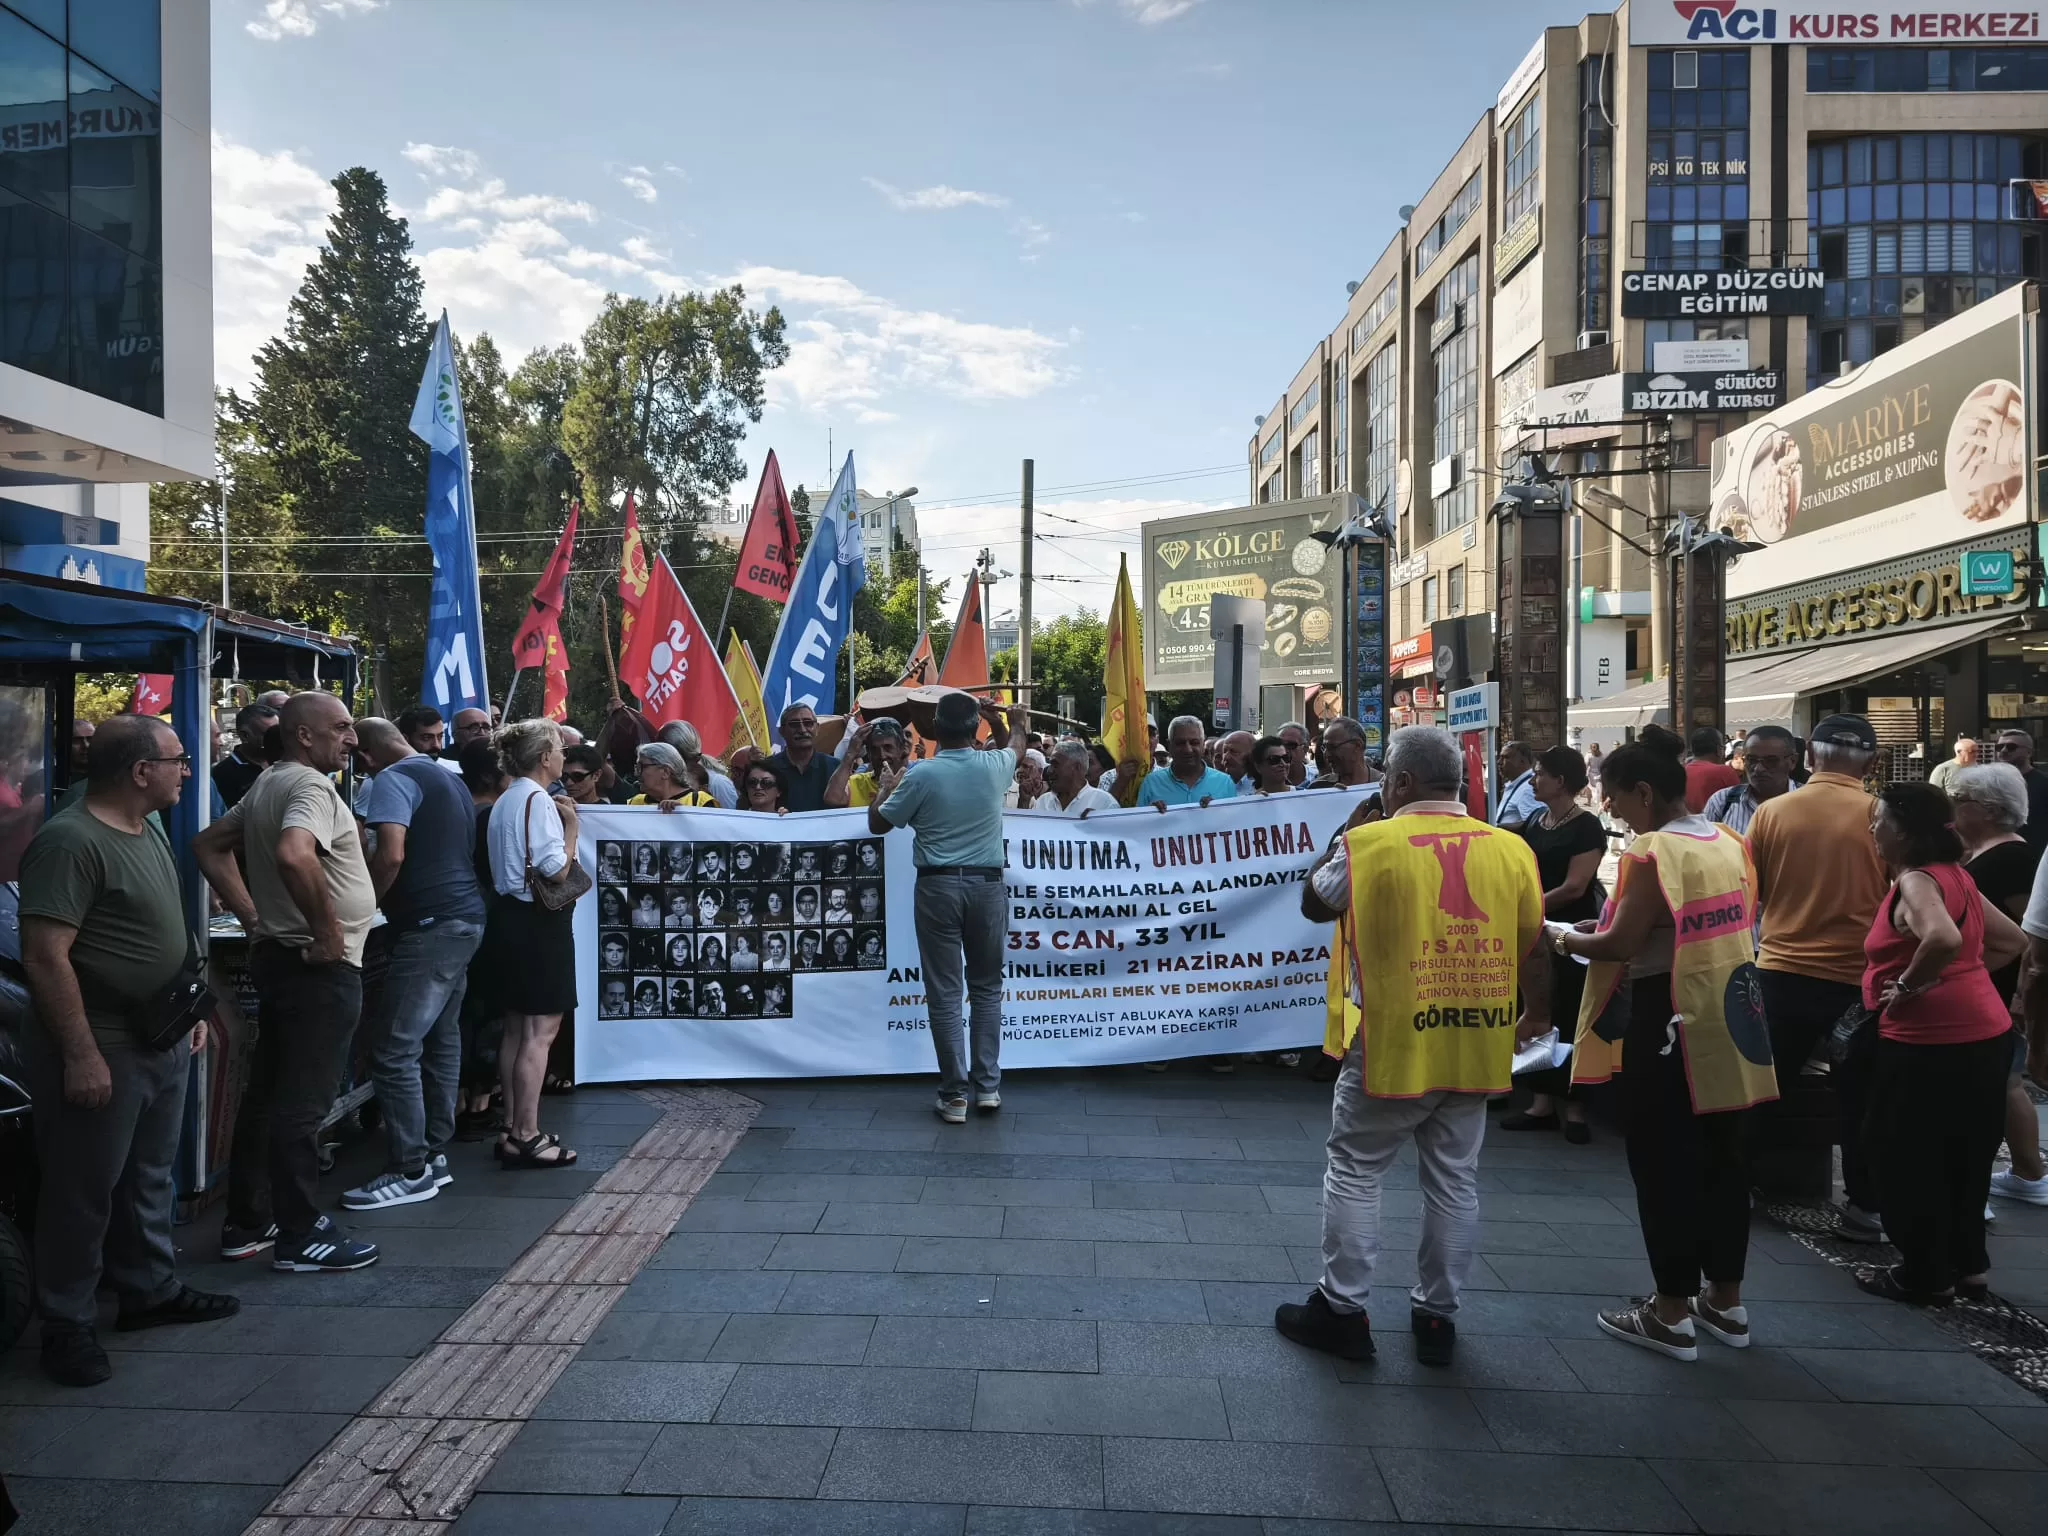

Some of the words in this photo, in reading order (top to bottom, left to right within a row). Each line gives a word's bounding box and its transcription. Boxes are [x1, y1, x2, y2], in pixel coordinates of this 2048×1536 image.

[1687, 9, 1776, 40] ACI
[1789, 13, 1879, 38] KURS
[1624, 272, 1708, 292] CENAP
[1717, 269, 1824, 290] DÜZGÜN
[1681, 292, 1768, 313] EĞİTİM
[1715, 373, 1777, 390] SÜRÜCÜ
[1717, 394, 1776, 408] KURSU
[1825, 431, 1915, 480] ACCESSORIES
[1851, 471, 1882, 495] STEEL
[1194, 529, 1286, 560] KÖLGE
[1206, 554, 1273, 569] KUYUMCULUK
[1169, 585, 1183, 598] 14
[1726, 602, 1778, 652] RİYE
[1166, 646, 1187, 654] 0506
[1189, 644, 1205, 652] 990
[1599, 657, 1610, 686] TEB
[1022, 839, 1141, 872] UNUTMA,
[1151, 822, 1315, 868] UNUTTURMA
[1045, 881, 1184, 899] SEMAHLARLA
[1192, 868, 1309, 894] ALANDAYIZ
[1014, 902, 1137, 920] BAĞLAMANI
[1145, 903, 1171, 916] AL
[1178, 899, 1217, 915] GEL
[1007, 931, 1041, 949] 33
[1052, 929, 1124, 951] CAN,
[1135, 928, 1169, 946] 33
[1180, 922, 1226, 942] YIL
[1446, 924, 1479, 935] 2009
[887, 967, 920, 983] AN
[1127, 960, 1148, 974] 21
[1157, 951, 1263, 972] HAZİRAN
[1272, 946, 1331, 966] PAZA
[1480, 957, 1514, 968] ABDAL
[1416, 971, 1457, 987] KÜLTÜR
[1461, 970, 1510, 983] DERNEĞİ
[889, 995, 928, 1006] ANTA
[1016, 986, 1107, 1001] KURUMLARI
[1113, 985, 1155, 997] EMEK
[1160, 984, 1180, 995] VE
[1186, 975, 1278, 994] DEMOKRASİ
[1416, 987, 1469, 1001] ALTINOVA
[888, 1018, 930, 1032] FAŞİS
[1023, 1010, 1115, 1026] EMPERYALİST
[1120, 1008, 1193, 1021] ABLUKAYA
[1199, 1006, 1238, 1020] KARŞI
[1244, 996, 1327, 1014] ALANLARDA
[1413, 1001, 1513, 1032] GÖREVLİ
[1003, 1026, 1103, 1041] MÜCADELEMİZ
[1108, 1024, 1156, 1037] DEVAM
[1162, 1018, 1238, 1034] EDECEKTİR
